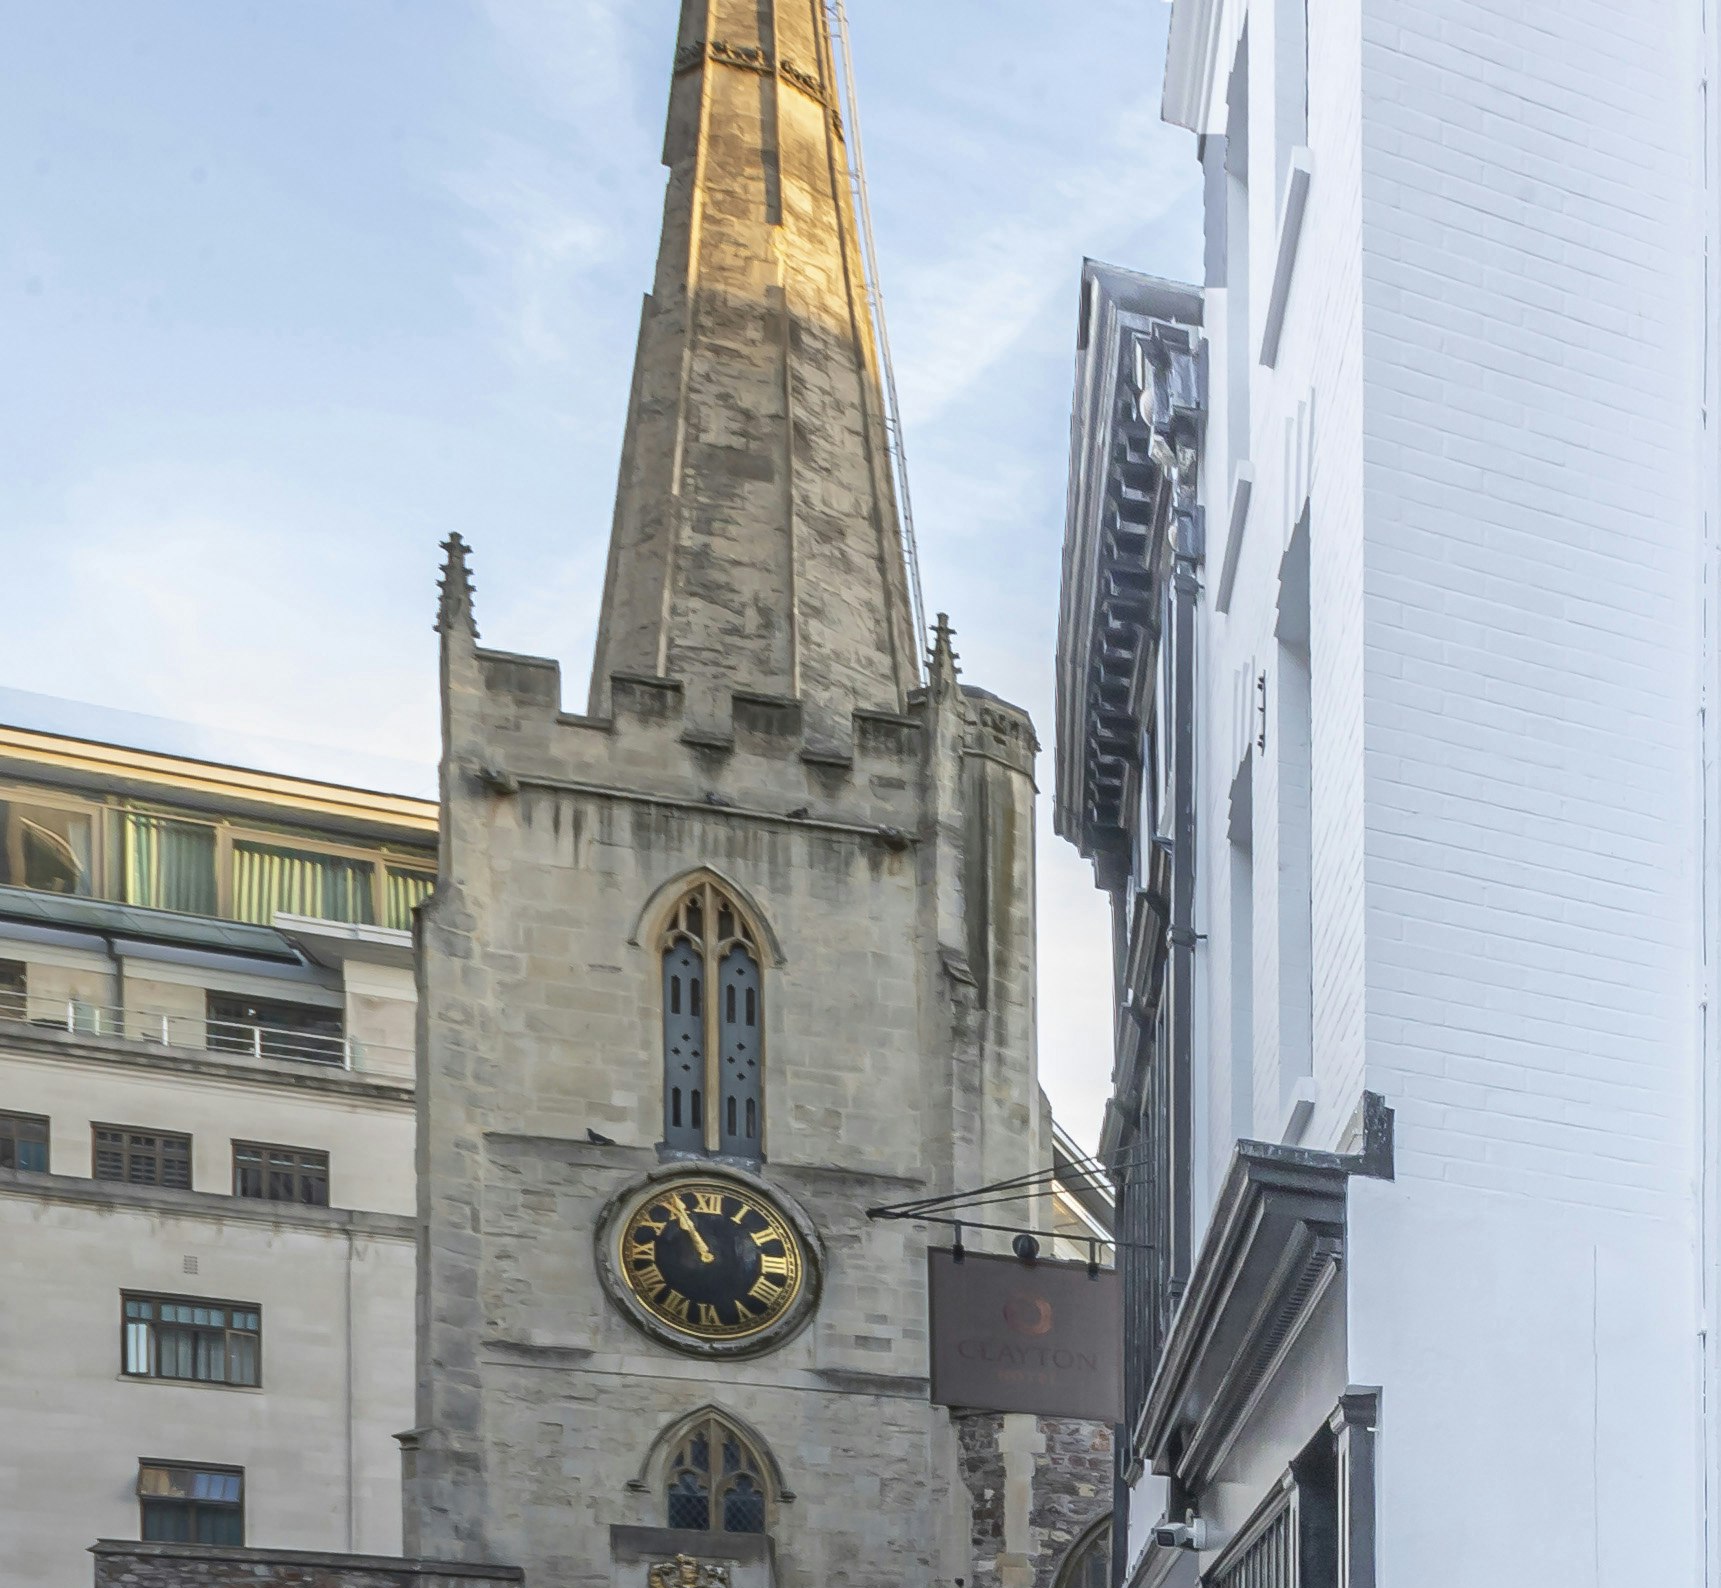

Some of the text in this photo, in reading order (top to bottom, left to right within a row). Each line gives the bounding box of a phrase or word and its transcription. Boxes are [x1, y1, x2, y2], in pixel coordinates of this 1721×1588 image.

[693, 1192, 723, 1215] XII
[730, 1203, 752, 1224] I
[636, 1216, 667, 1236] X
[751, 1225, 780, 1246] II
[632, 1240, 655, 1260] IX
[761, 1253, 788, 1276] III
[662, 1288, 690, 1322] VII
[697, 1303, 723, 1326] VI
[957, 1338, 1098, 1371] CLAYTON
